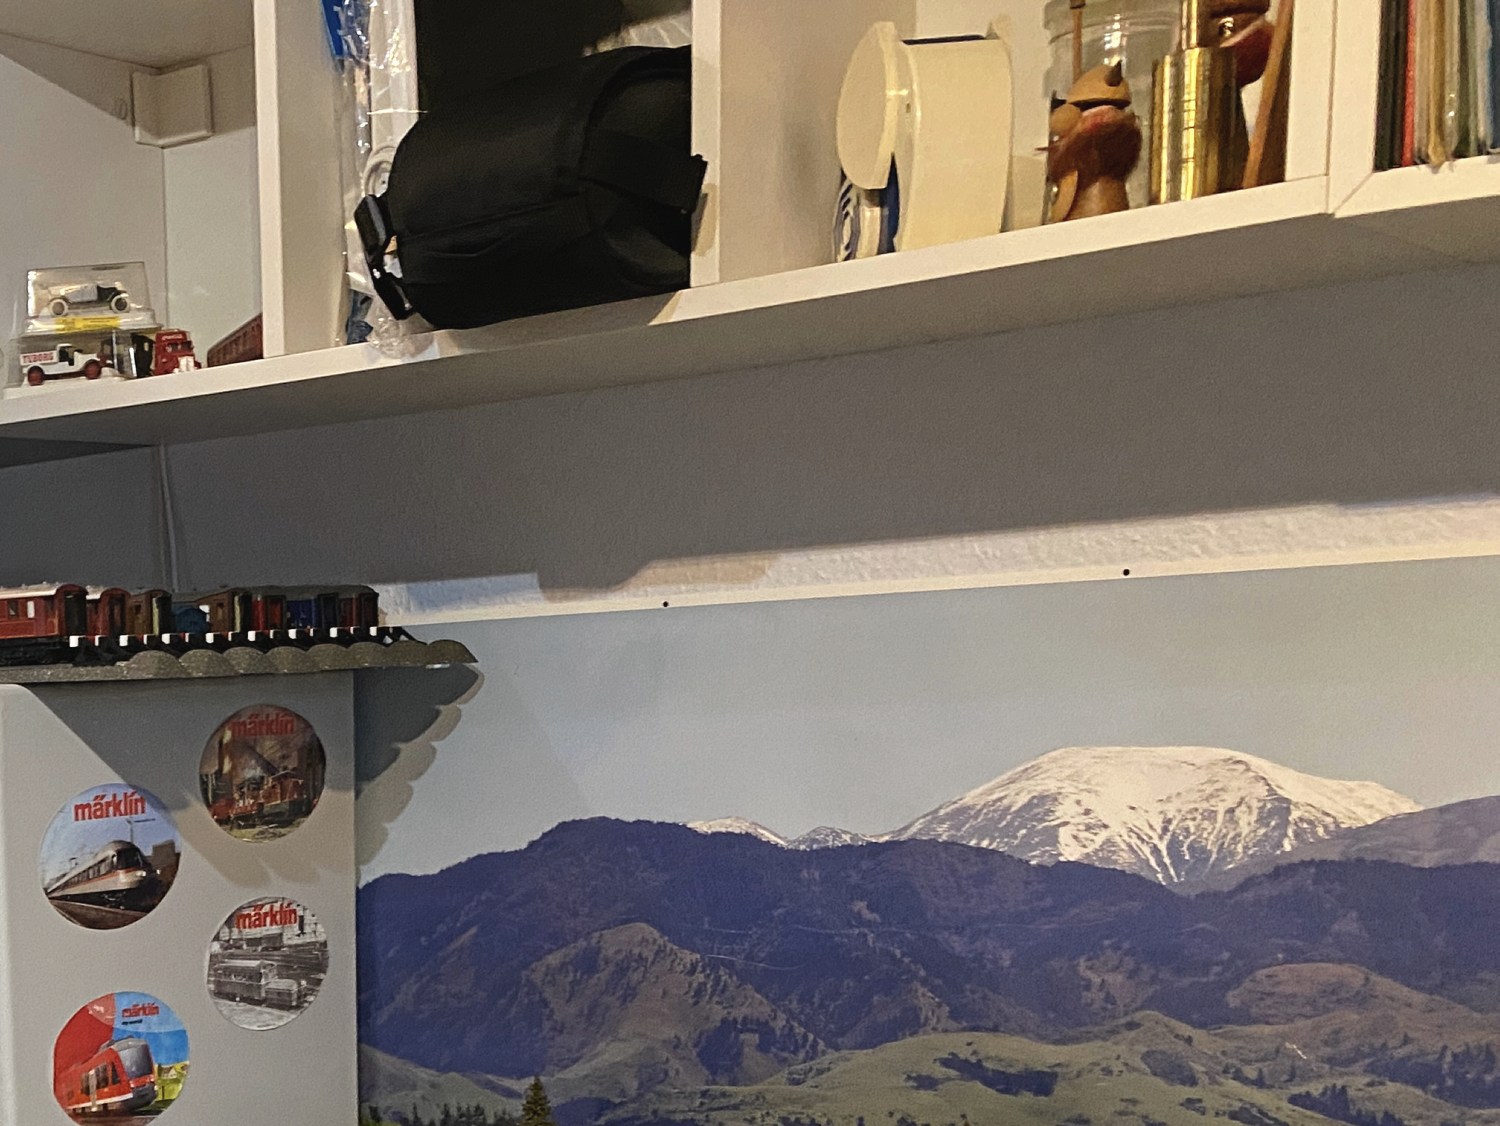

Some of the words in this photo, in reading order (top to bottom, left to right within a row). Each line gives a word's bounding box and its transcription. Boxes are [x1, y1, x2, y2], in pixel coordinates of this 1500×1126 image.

[23, 352, 54, 364] TUBORG
[74, 790, 147, 822] märklin
[235, 902, 298, 929] märklin
[121, 1002, 160, 1018] märklin
